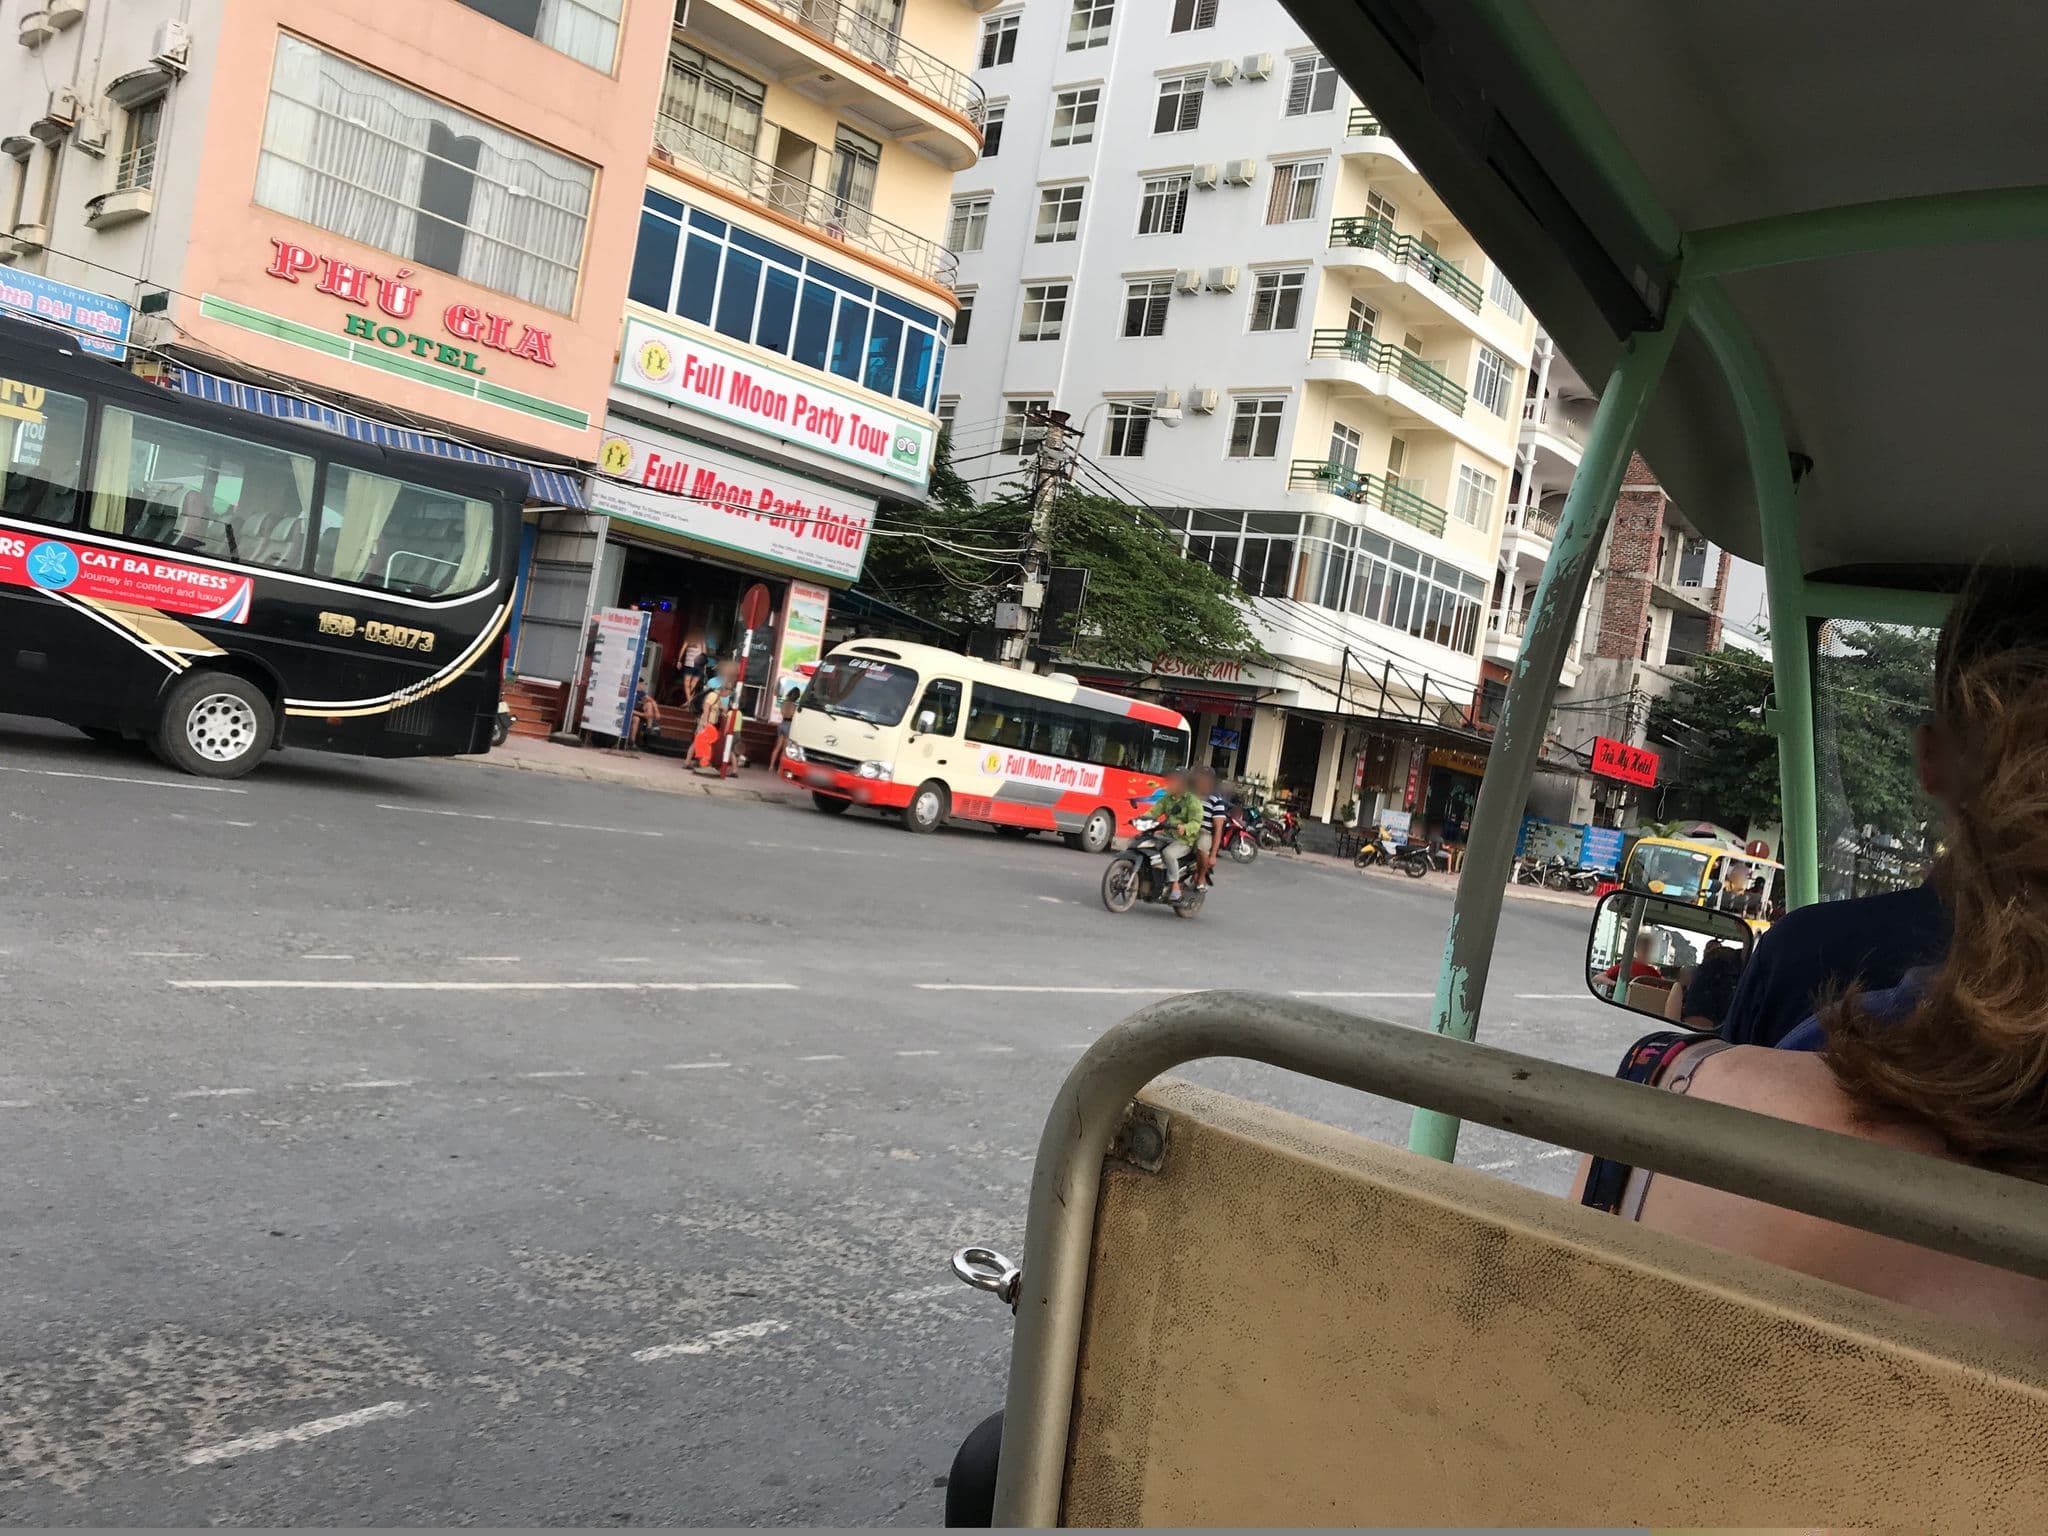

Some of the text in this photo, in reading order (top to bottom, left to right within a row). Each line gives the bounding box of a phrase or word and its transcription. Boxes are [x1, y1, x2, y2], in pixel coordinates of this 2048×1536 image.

[266, 236, 422, 319] PHÚ
[443, 303, 556, 368] GIA
[343, 313, 486, 376] HOTEL
[682, 353, 725, 400] Full
[729, 370, 788, 425] Moon
[791, 392, 844, 445] Party
[848, 414, 890, 457] Tour
[642, 453, 689, 496] Full
[692, 468, 752, 519] Moon
[754, 487, 811, 538] Party
[811, 504, 866, 550] Hotel
[0, 536, 26, 558] RS
[80, 551, 229, 590] CAT BA EXPRESS
[80, 570, 121, 587] Journey
[124, 577, 133, 587] in
[136, 580, 174, 595] comfort
[176, 588, 195, 599] and
[197, 589, 225, 604] luxury
[318, 611, 436, 653] 15B-03073
[1005, 754, 1098, 788] Full Moon Party Tour
